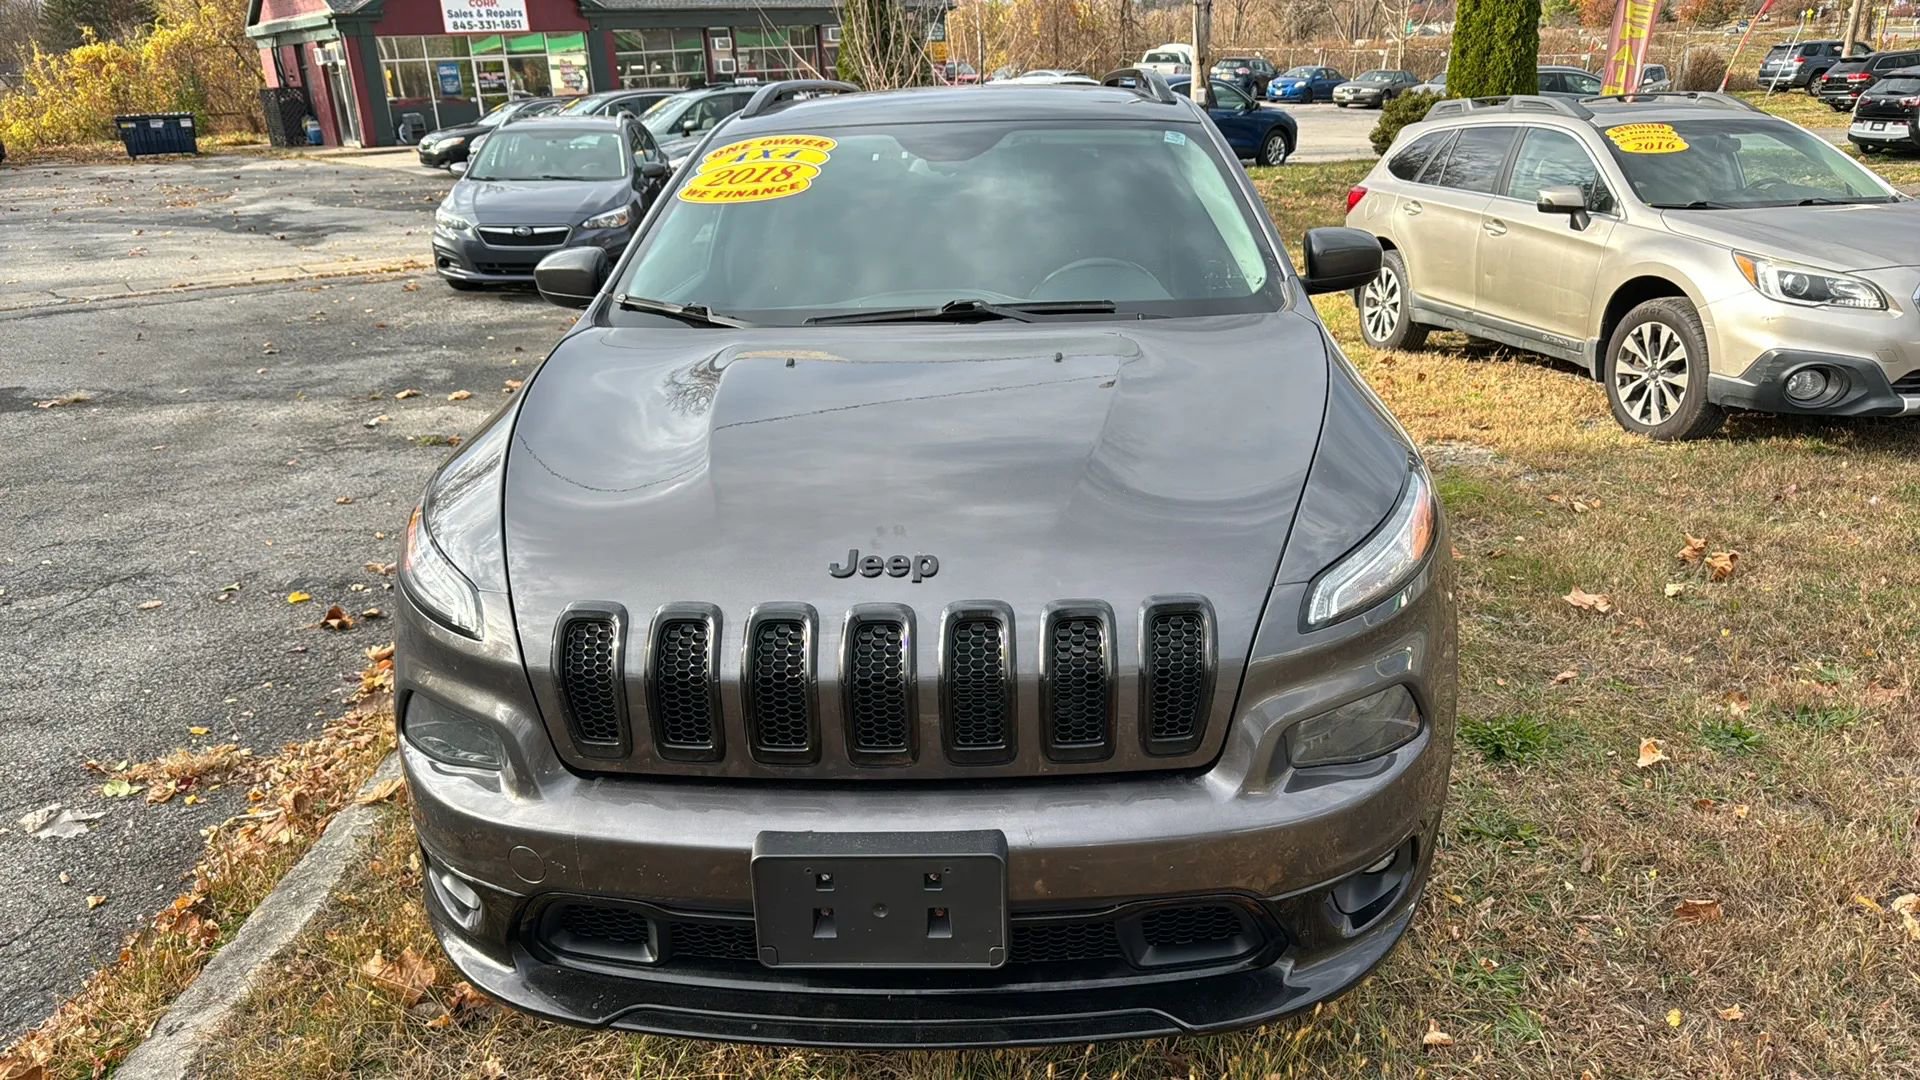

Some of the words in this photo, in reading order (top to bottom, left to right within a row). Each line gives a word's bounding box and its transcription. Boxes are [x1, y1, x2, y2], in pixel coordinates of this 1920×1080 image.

[447, 9, 474, 18] Sales
[476, 9, 483, 17] &
[486, 8, 523, 18] Repairs
[452, 20, 522, 30] 845-331-1851
[712, 143, 752, 159] ONE
[760, 138, 830, 148] OWNER
[1633, 141, 1676, 151] 2016
[705, 164, 802, 187] 2018
[685, 188, 709, 198] WE
[713, 181, 800, 198] FINANCE
[828, 549, 939, 583] Jeep
